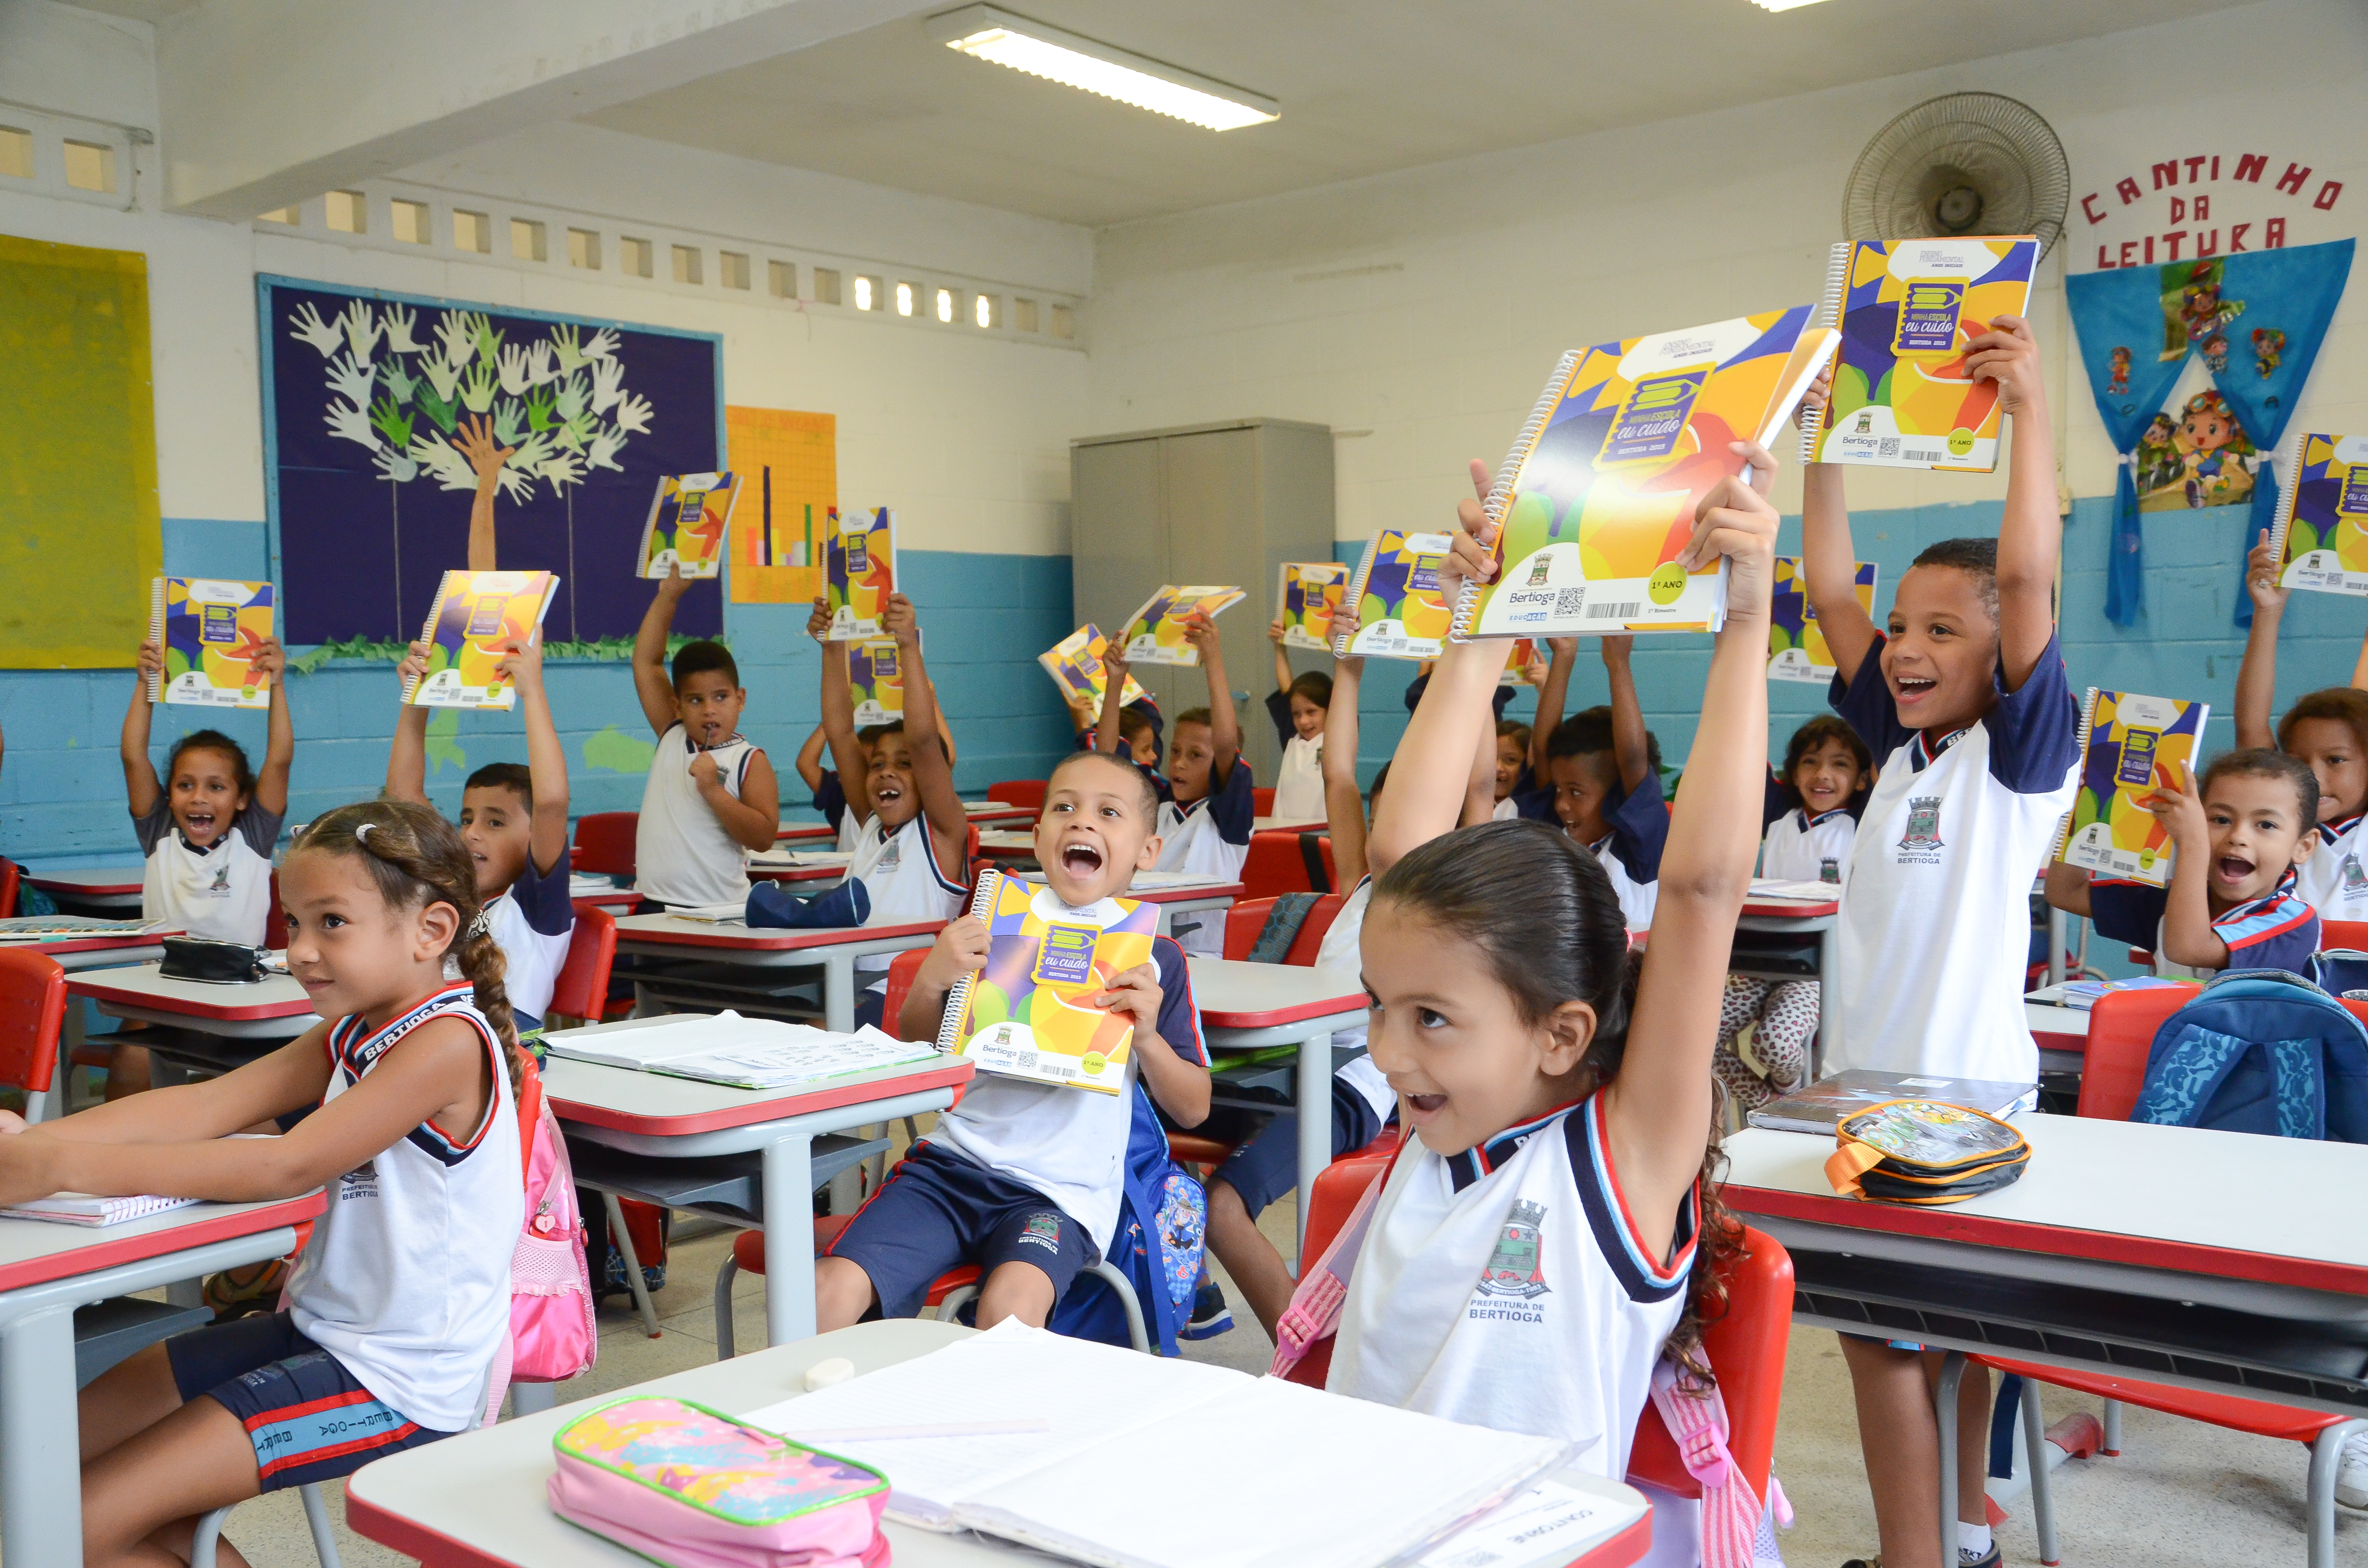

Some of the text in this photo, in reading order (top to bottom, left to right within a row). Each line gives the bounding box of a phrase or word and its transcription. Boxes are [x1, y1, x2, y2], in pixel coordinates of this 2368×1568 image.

[2081, 153, 2343, 224] CANTINHO
[2171, 195, 2209, 224] DA
[2098, 217, 2285, 269] LEITURA
[1905, 319, 1954, 332] eu cuido
[1617, 416, 1681, 439] eu cuido
[1842, 436, 1877, 447] Bertioga
[1618, 446, 1647, 454] BERTIOGA
[1663, 581, 1683, 589] ANO
[1509, 591, 1555, 605] Bertioga
[1045, 957, 1088, 969] eu cuido
[364, 1003, 446, 1061] BERTIOGA
[983, 1045, 1017, 1058] Bertioga
[1018, 1239, 1057, 1255] BERTIOGA
[1470, 1299, 1529, 1310] PREFEITURA
[1469, 1309, 1543, 1323] BERTIOGA
[319, 1411, 393, 1436] BERTIOGA
